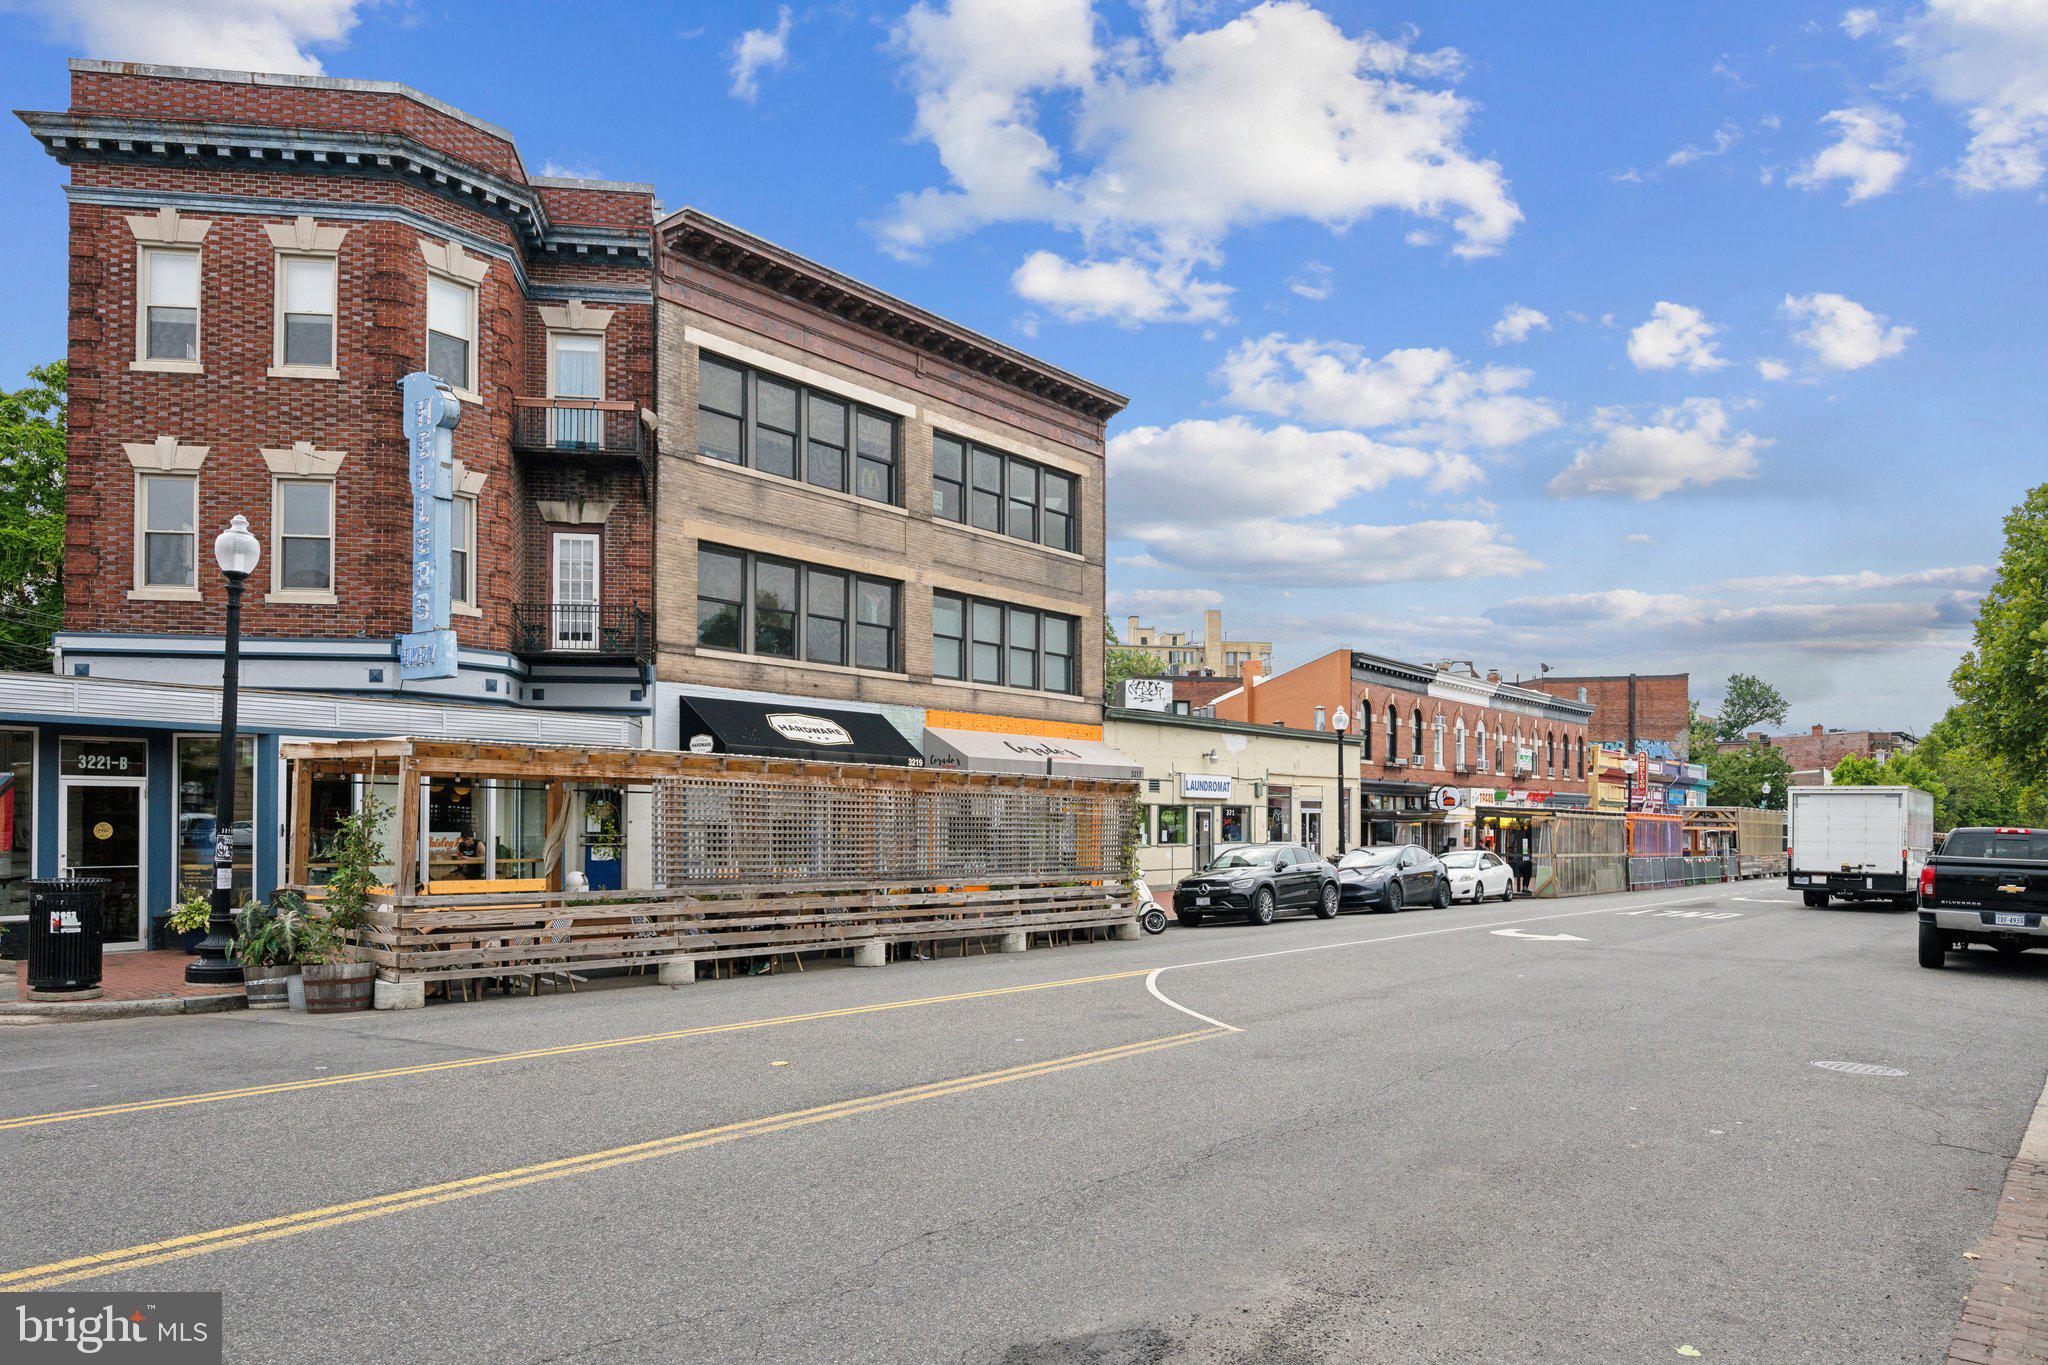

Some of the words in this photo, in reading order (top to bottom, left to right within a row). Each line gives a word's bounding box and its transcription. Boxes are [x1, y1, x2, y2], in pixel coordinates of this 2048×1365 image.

[778, 724, 844, 736] HARDWARE
[78, 754, 128, 770] 3221-B
[908, 758, 923, 767] 3219
[1185, 780, 1231, 792] LAUNDROMAT
[1479, 793, 1494, 803] TACOS
